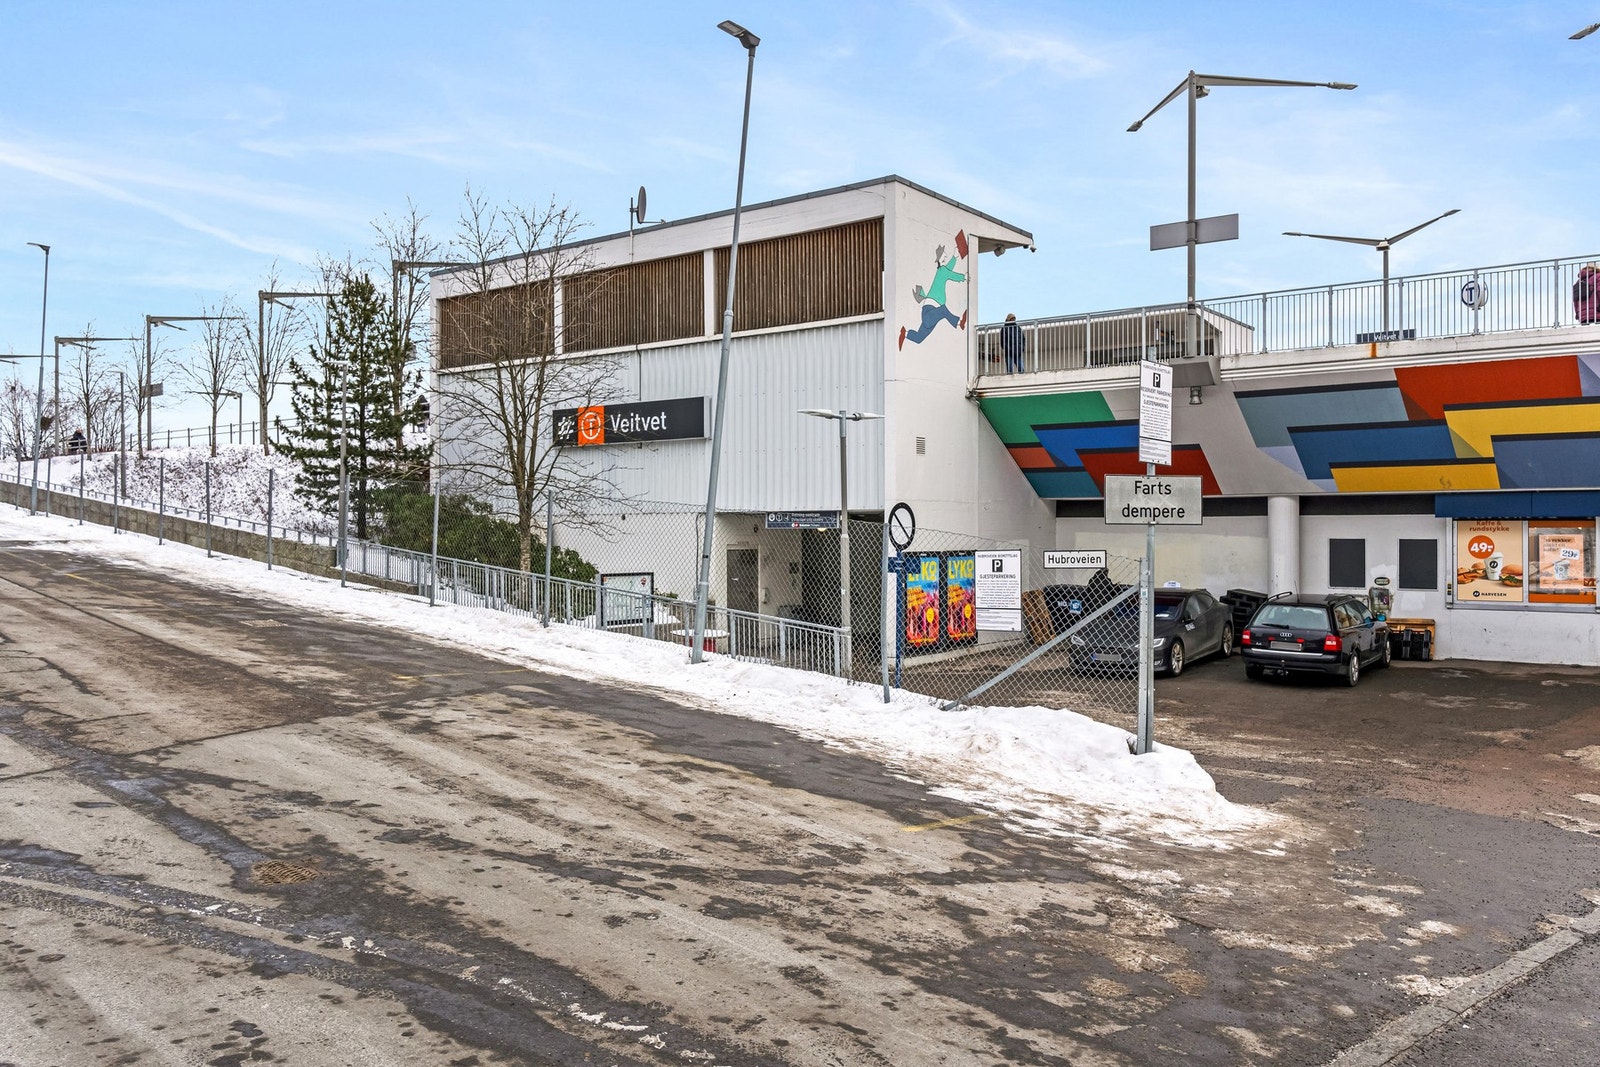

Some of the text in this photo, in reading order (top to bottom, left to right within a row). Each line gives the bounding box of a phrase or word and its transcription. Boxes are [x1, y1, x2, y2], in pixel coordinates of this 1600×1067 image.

[610, 411, 667, 434] Veitvet
[1134, 480, 1172, 495] Farts
[1122, 503, 1185, 522] dempere
[1469, 525, 1510, 533] rundstykke
[1048, 554, 1102, 565] Hubroveien
